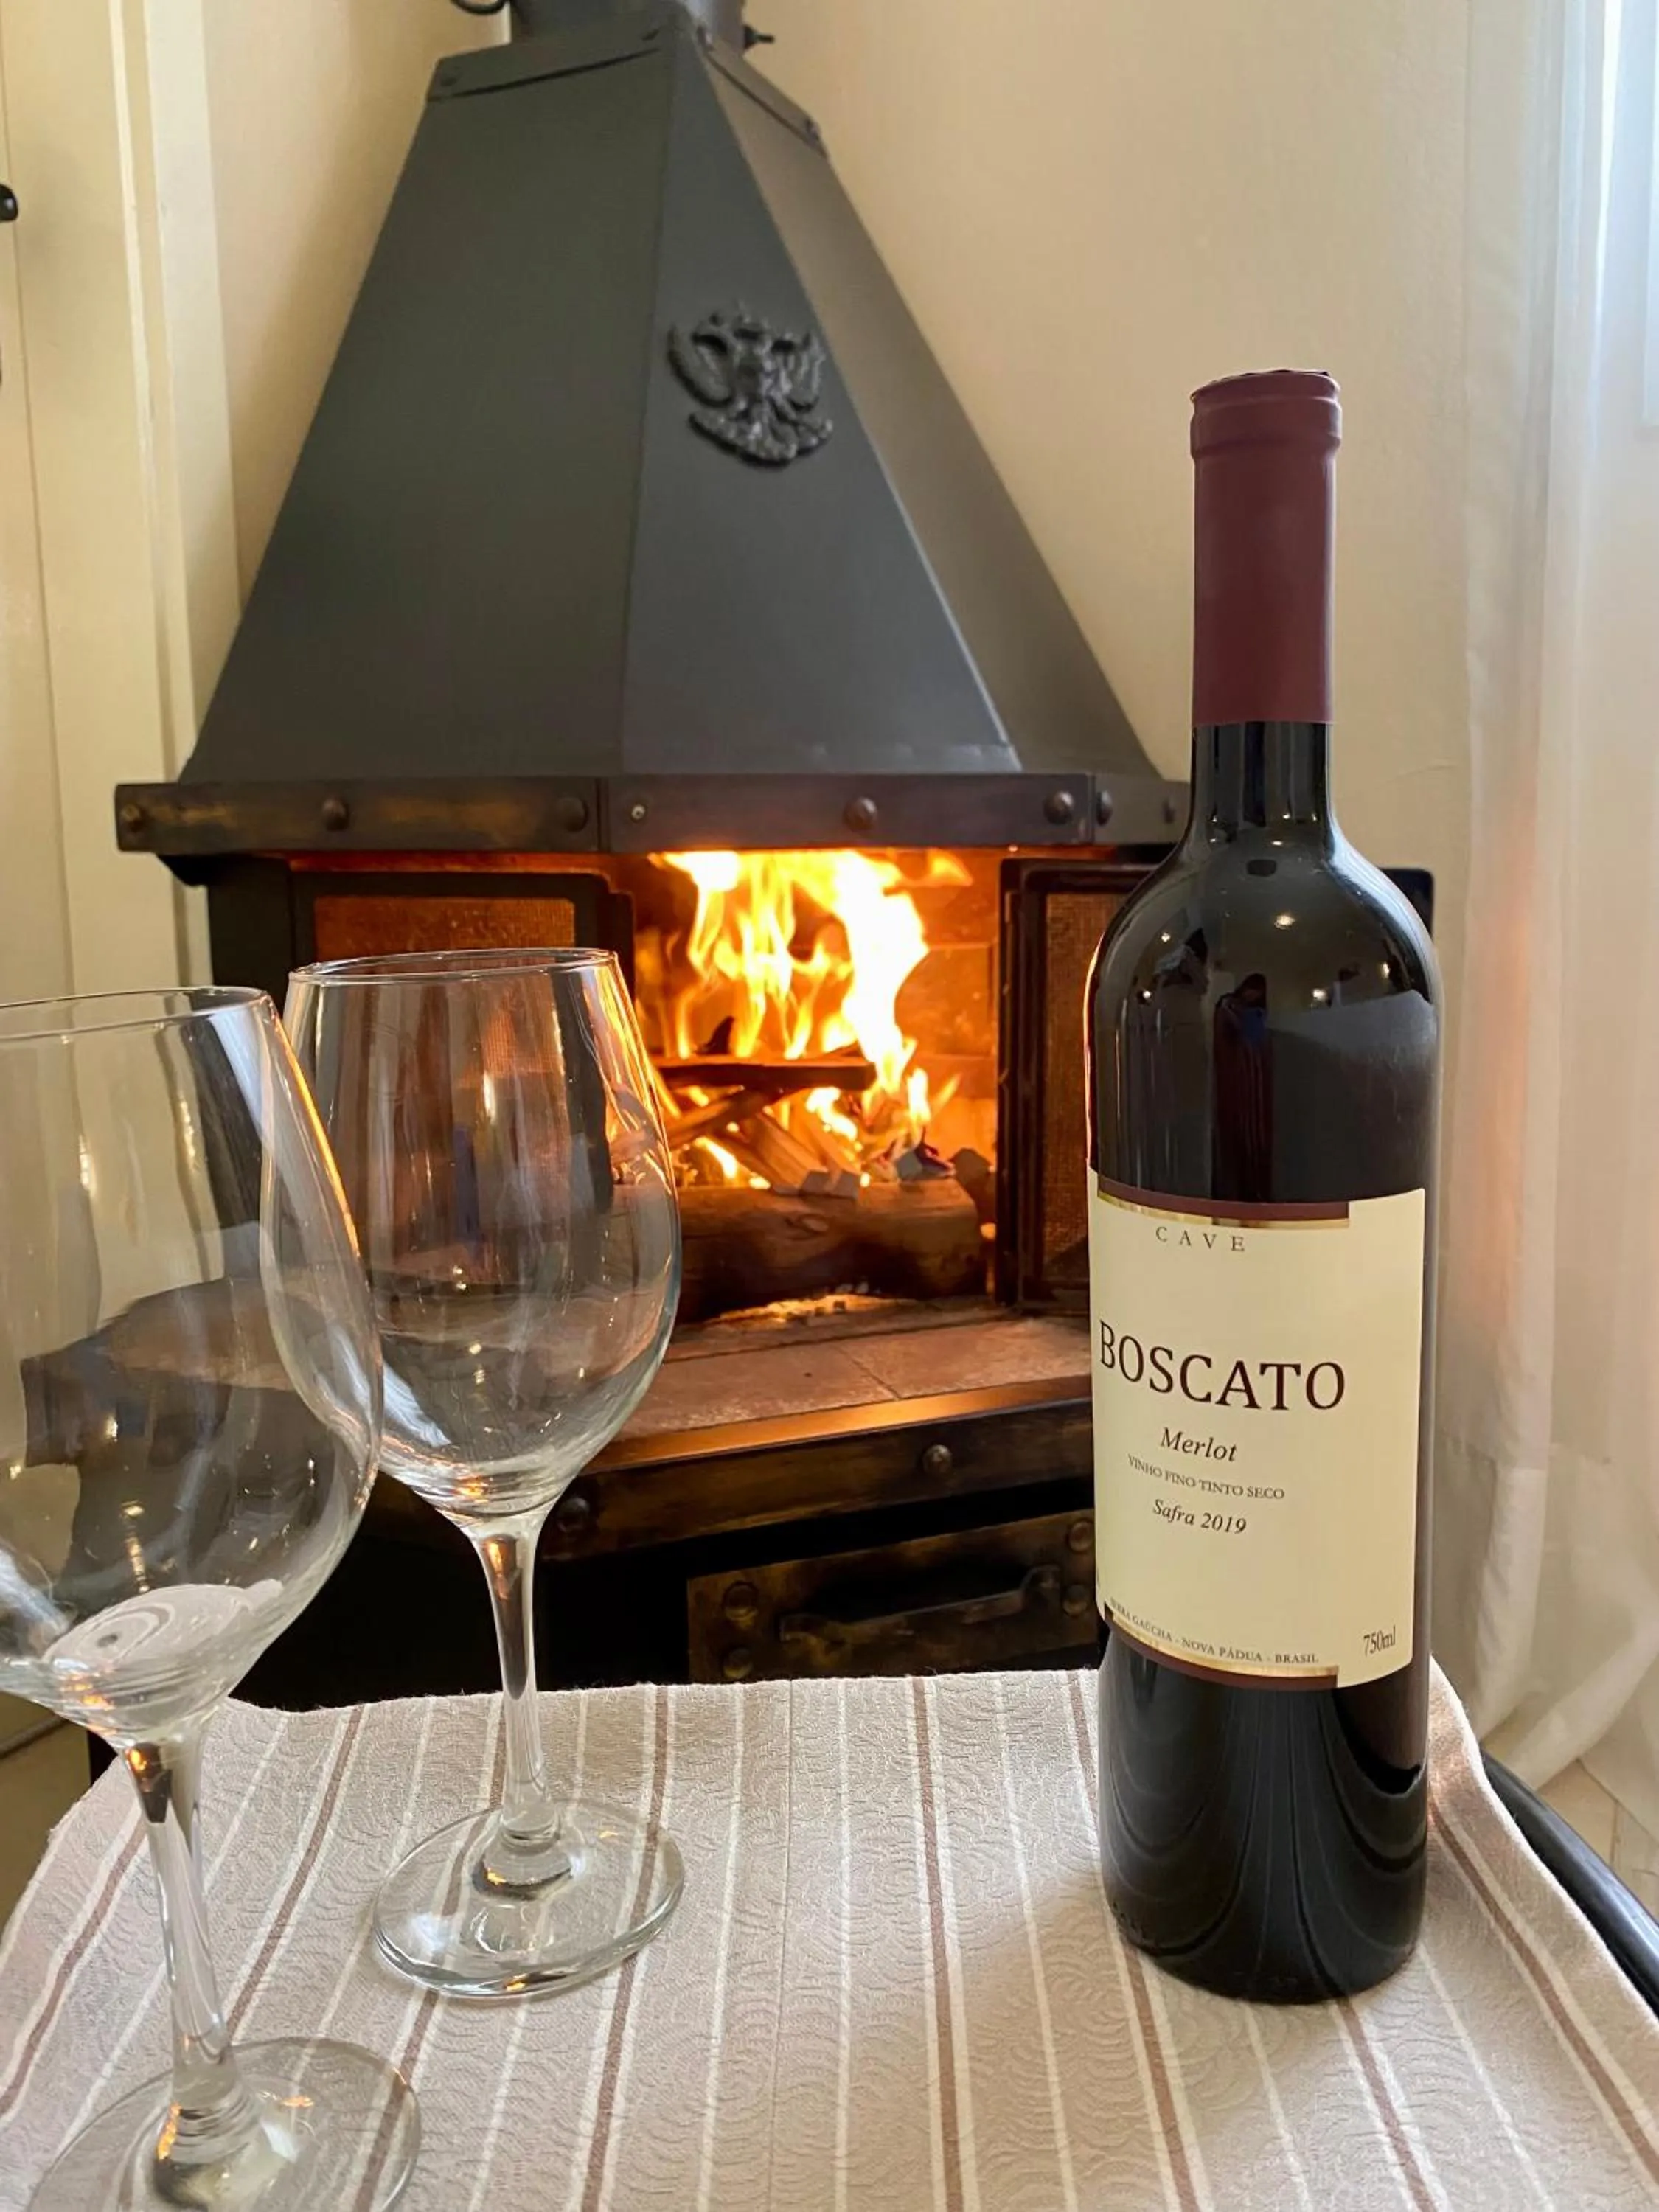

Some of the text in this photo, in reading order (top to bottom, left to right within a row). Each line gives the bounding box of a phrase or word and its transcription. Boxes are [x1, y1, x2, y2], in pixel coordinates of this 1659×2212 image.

[1155, 1226, 1245, 1251] CAVE
[1099, 1319, 1345, 1411] BOSCATO
[1160, 1427, 1237, 1462] Merlot
[1127, 1453, 1285, 1500] VINHO FINO TINTO SECO
[1152, 1498, 1248, 1534] Safra 2019
[1181, 1636, 1215, 1655] NOVA
[1219, 1645, 1263, 1662] PÁDUA
[1274, 1653, 1320, 1664] BRASIL
[1363, 1624, 1396, 1658] 750ml
